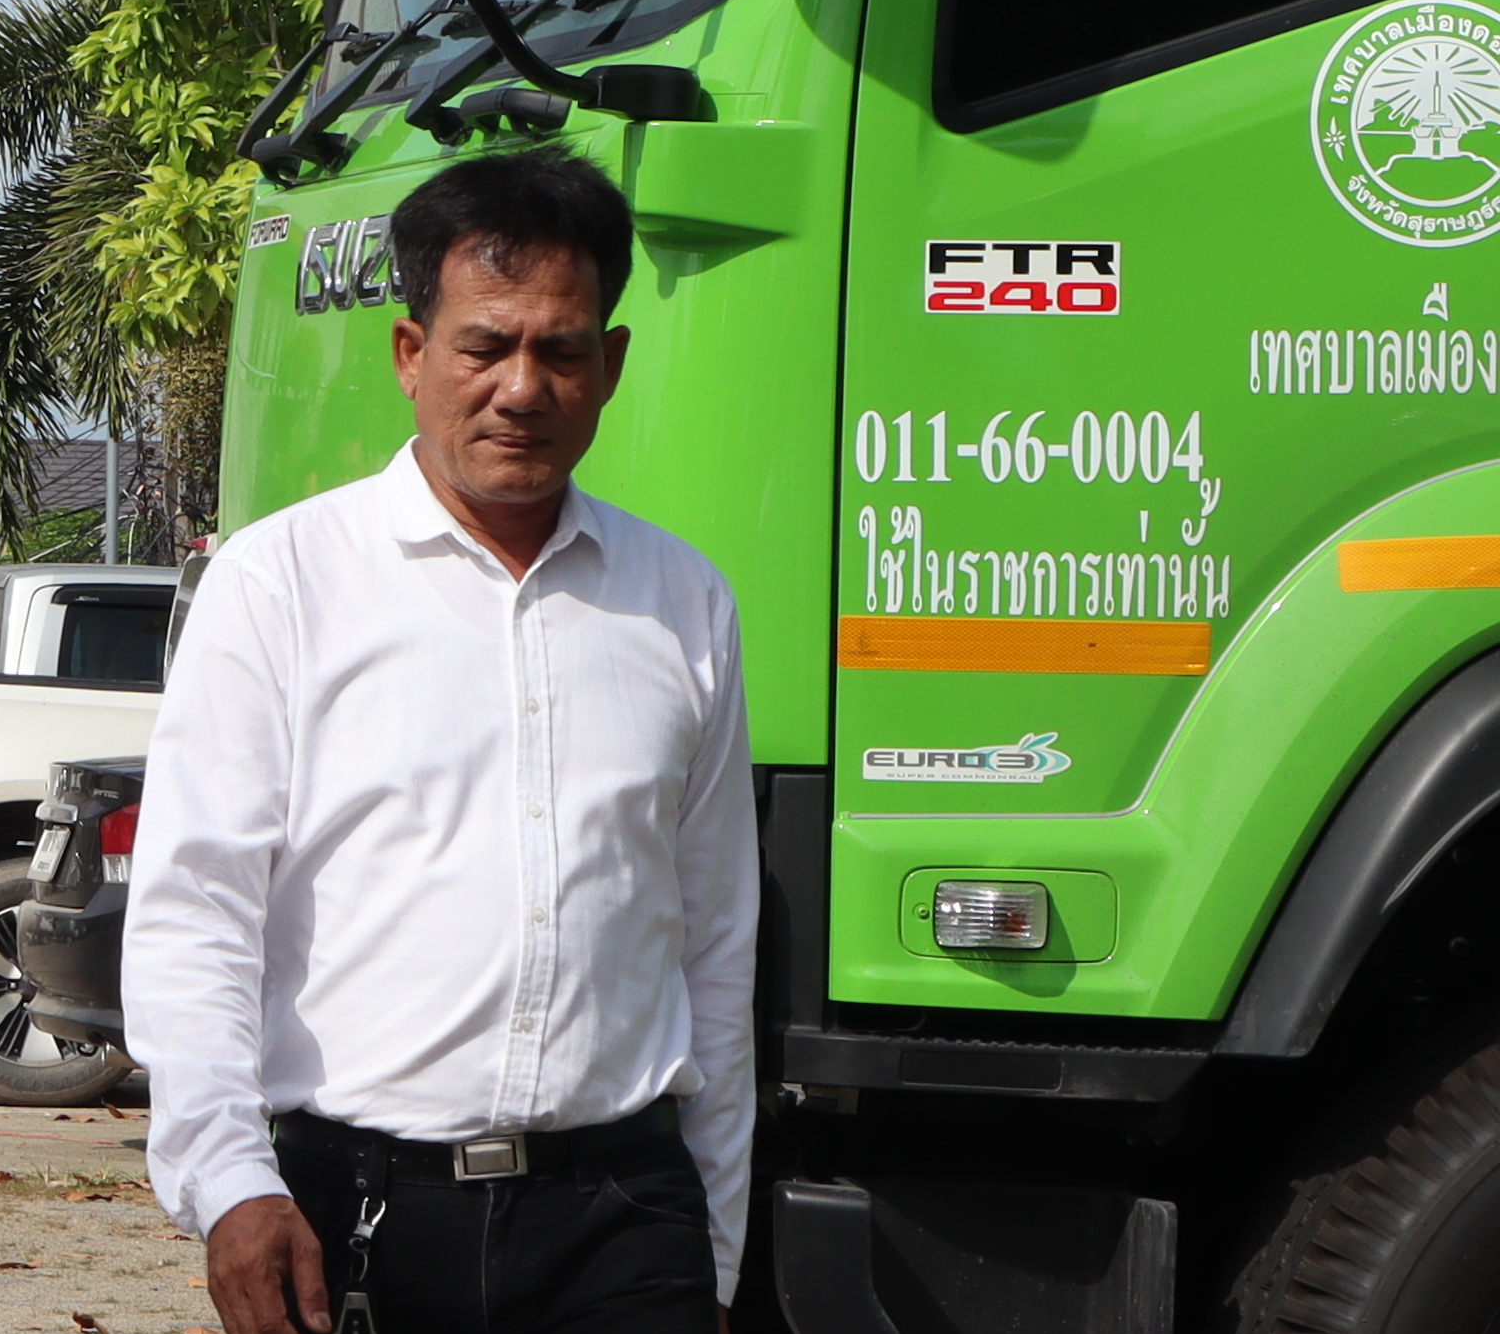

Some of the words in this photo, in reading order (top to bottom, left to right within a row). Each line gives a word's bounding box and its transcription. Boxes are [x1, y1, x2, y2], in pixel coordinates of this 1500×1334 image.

[928, 243, 1115, 275] FTR
[927, 281, 1118, 312] 240
[855, 409, 1204, 484] 011-66-0004
[858, 477, 1231, 619] ใช้ในราชการเท่านั้น
[866, 751, 987, 768] EURO
